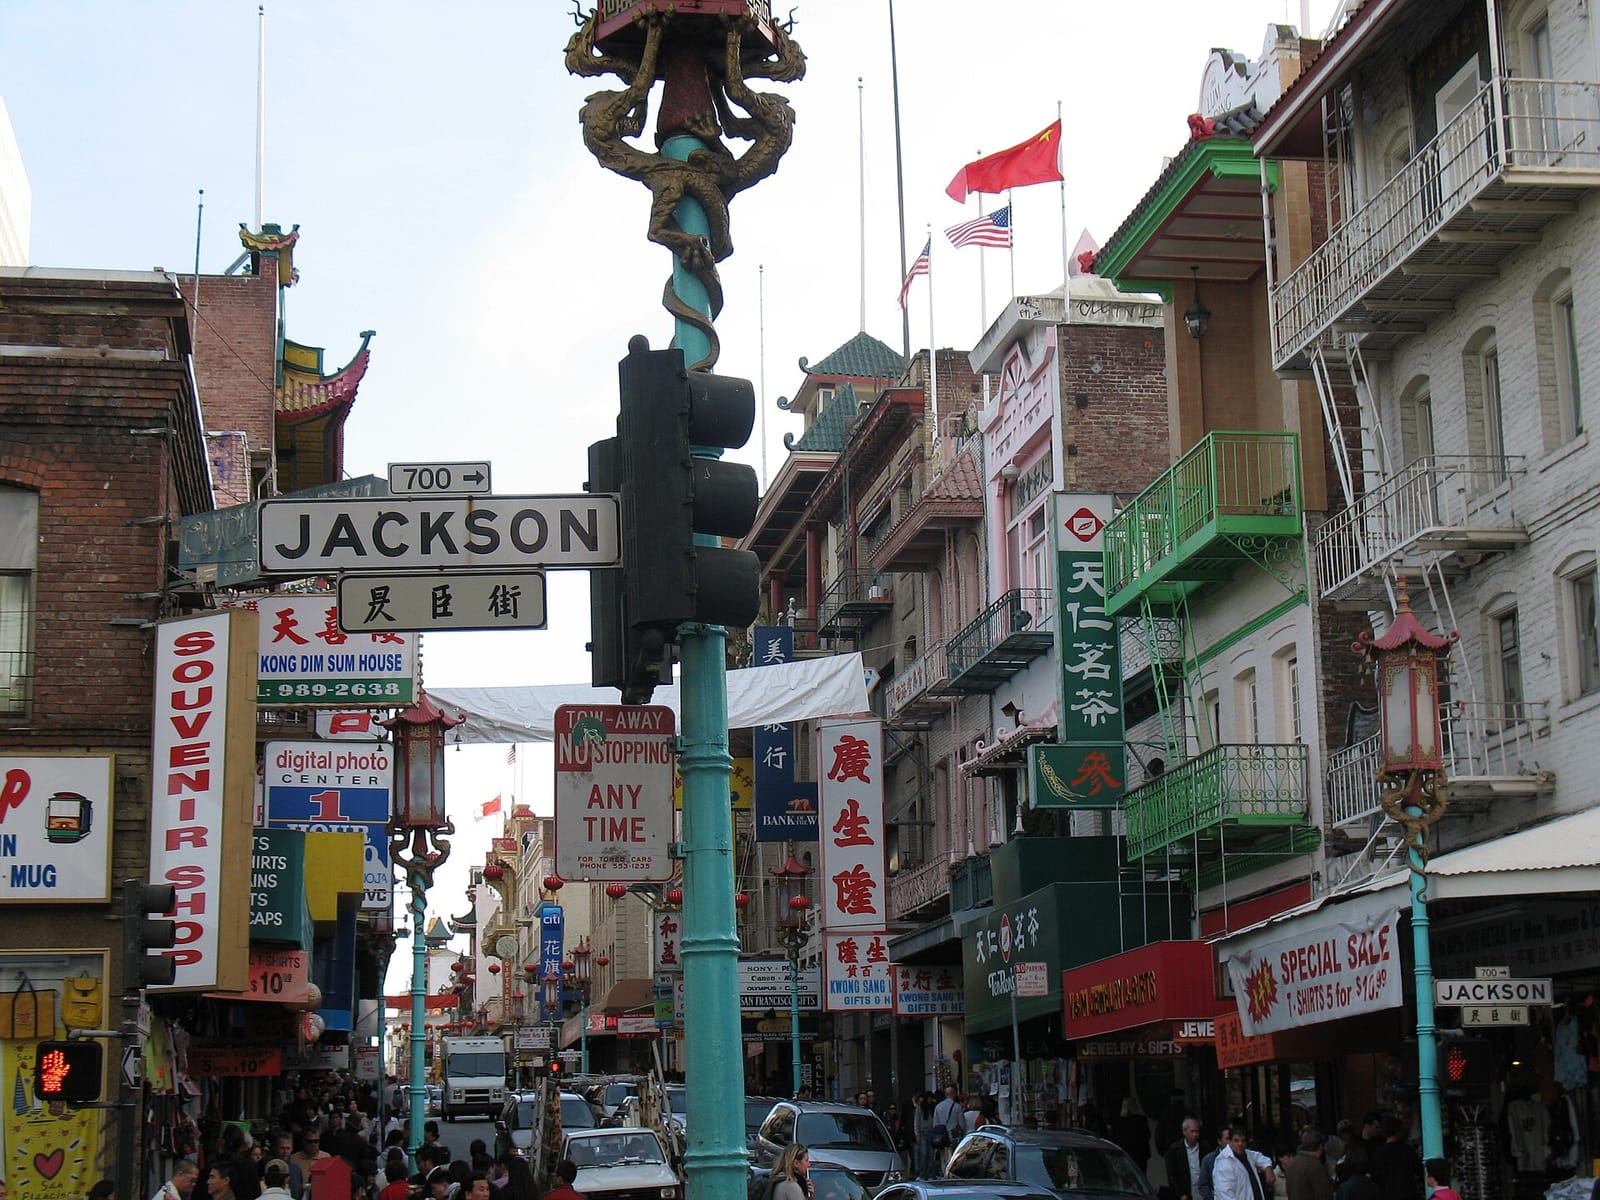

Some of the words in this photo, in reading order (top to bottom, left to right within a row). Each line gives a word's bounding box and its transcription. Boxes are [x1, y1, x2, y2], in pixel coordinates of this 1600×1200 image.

[403, 469, 451, 489] 700
[274, 509, 599, 559] JACKSON
[363, 585, 522, 624] 昃臣街
[272, 607, 405, 645] 天喜
[1065, 561, 1119, 727] 天仁茗茶
[261, 656, 296, 672] KONG
[301, 655, 323, 672] DIM
[328, 655, 354, 672] SUM
[359, 654, 402, 671] HOUSE
[279, 683, 400, 696] 989-2638
[164, 631, 215, 851] SOUVENIR
[559, 733, 588, 764] NO
[594, 741, 670, 764] STOPPING
[276, 750, 332, 772] digital
[336, 752, 388, 773] photo
[282, 775, 379, 785] CENTER
[310, 790, 350, 822] 1
[587, 784, 643, 809] ANY
[583, 817, 646, 842] TIME
[763, 816, 795, 825] BANK
[827, 735, 877, 916] 廣生隆
[11, 864, 57, 888] MUG
[543, 914, 560, 924] citi
[1280, 939, 1342, 985] SPECIAL
[1348, 925, 1390, 969] SALE
[1016, 963, 1025, 973] NO
[830, 979, 859, 994] KWONG
[863, 979, 886, 994] SANG
[899, 993, 929, 1003] KWONG
[931, 993, 953, 1002] SANG
[1132, 970, 1157, 1004] GIFTS
[1327, 985, 1334, 1009] 5
[1336, 983, 1352, 1008] for
[1442, 984, 1545, 1000] JACKSON
[844, 996, 871, 1005] GIFTS
[908, 1003, 936, 1012] GIFTS
[1082, 1041, 1135, 1055] JEWELRY
[1138, 1043, 1146, 1053] &
[1148, 1040, 1182, 1054] GIFTS
[202, 1060, 212, 1072] 5
